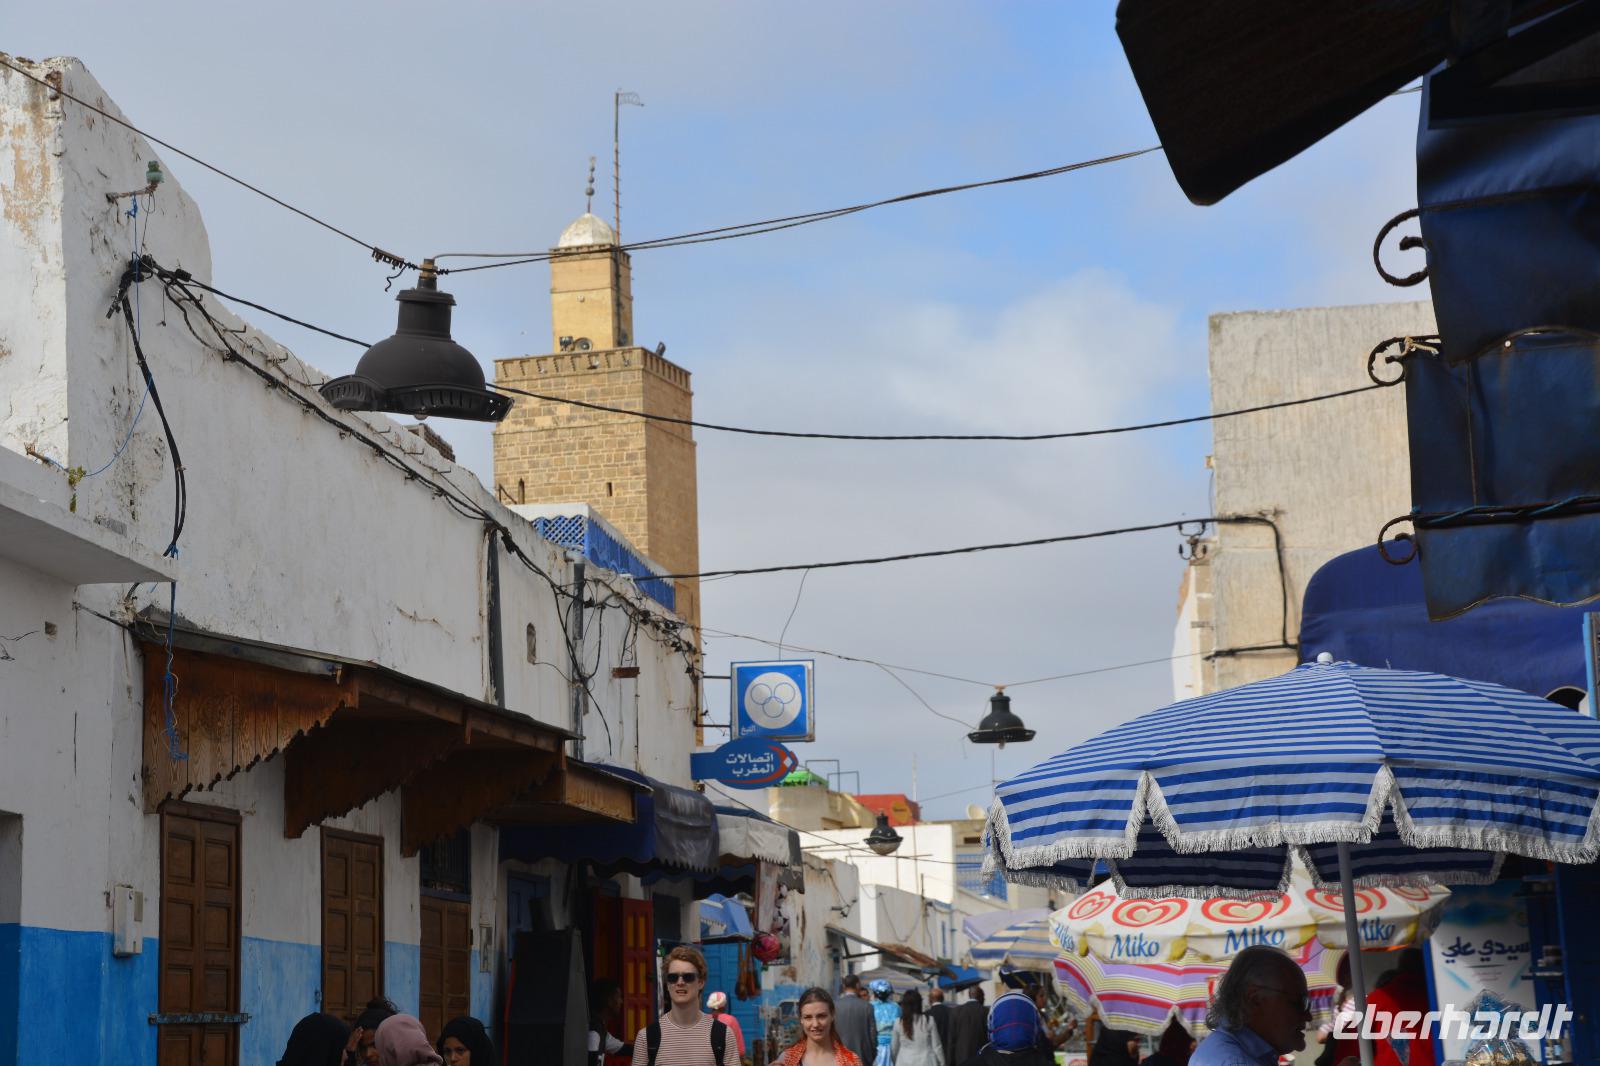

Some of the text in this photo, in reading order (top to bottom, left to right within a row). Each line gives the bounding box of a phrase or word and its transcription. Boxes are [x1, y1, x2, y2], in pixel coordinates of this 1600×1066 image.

[726, 753, 774, 764] اتصالات
[732, 764, 774, 777] المغرب
[1110, 932, 1160, 959] Miko
[1224, 925, 1285, 954] Miko
[1441, 936, 1530, 963] سيدي علي
